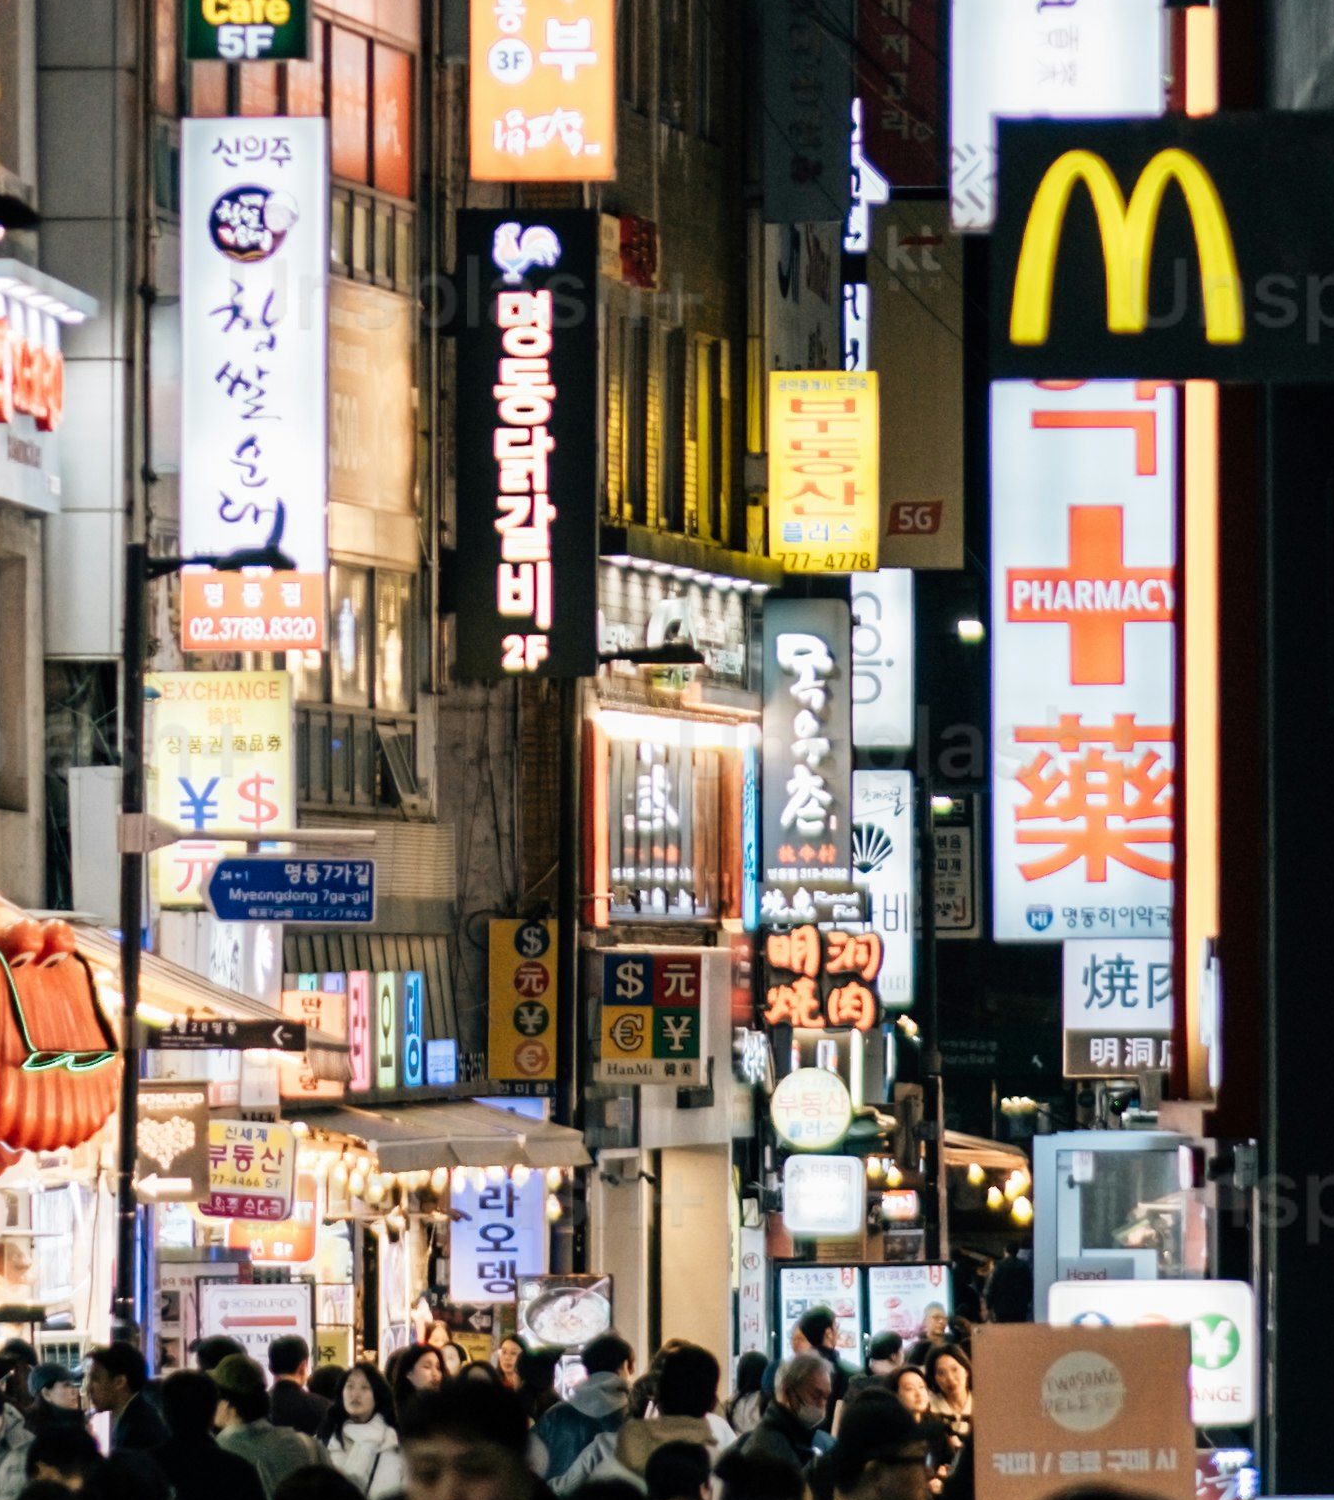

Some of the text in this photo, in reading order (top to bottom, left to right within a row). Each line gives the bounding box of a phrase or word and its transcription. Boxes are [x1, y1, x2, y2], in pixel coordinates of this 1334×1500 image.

[217, 24, 275, 59] 5F
[495, 50, 525, 71] 3F
[212, 135, 292, 168] 신의주
[885, 224, 943, 272] kt
[492, 289, 558, 632] 명동닭갈비
[783, 398, 866, 517] 부동산
[897, 504, 933, 532] 5G
[783, 522, 856, 543] 플러스
[777, 552, 871, 571] 777-4778
[1012, 578, 1175, 612] PHARMACY
[188, 614, 317, 642] 02.3789.8320
[501, 634, 549, 671] 2F
[161, 680, 281, 700] EXCHANGE
[283, 862, 371, 886] 명동7가길
[228, 887, 319, 905] Myeongdong
[662, 963, 697, 998] 元
[607, 1062, 654, 1077] HanMi
[209, 1144, 285, 1175] 부동산
[210, 1174, 261, 1188] 77-4466
[1190, 1386, 1243, 1402] ANGE
